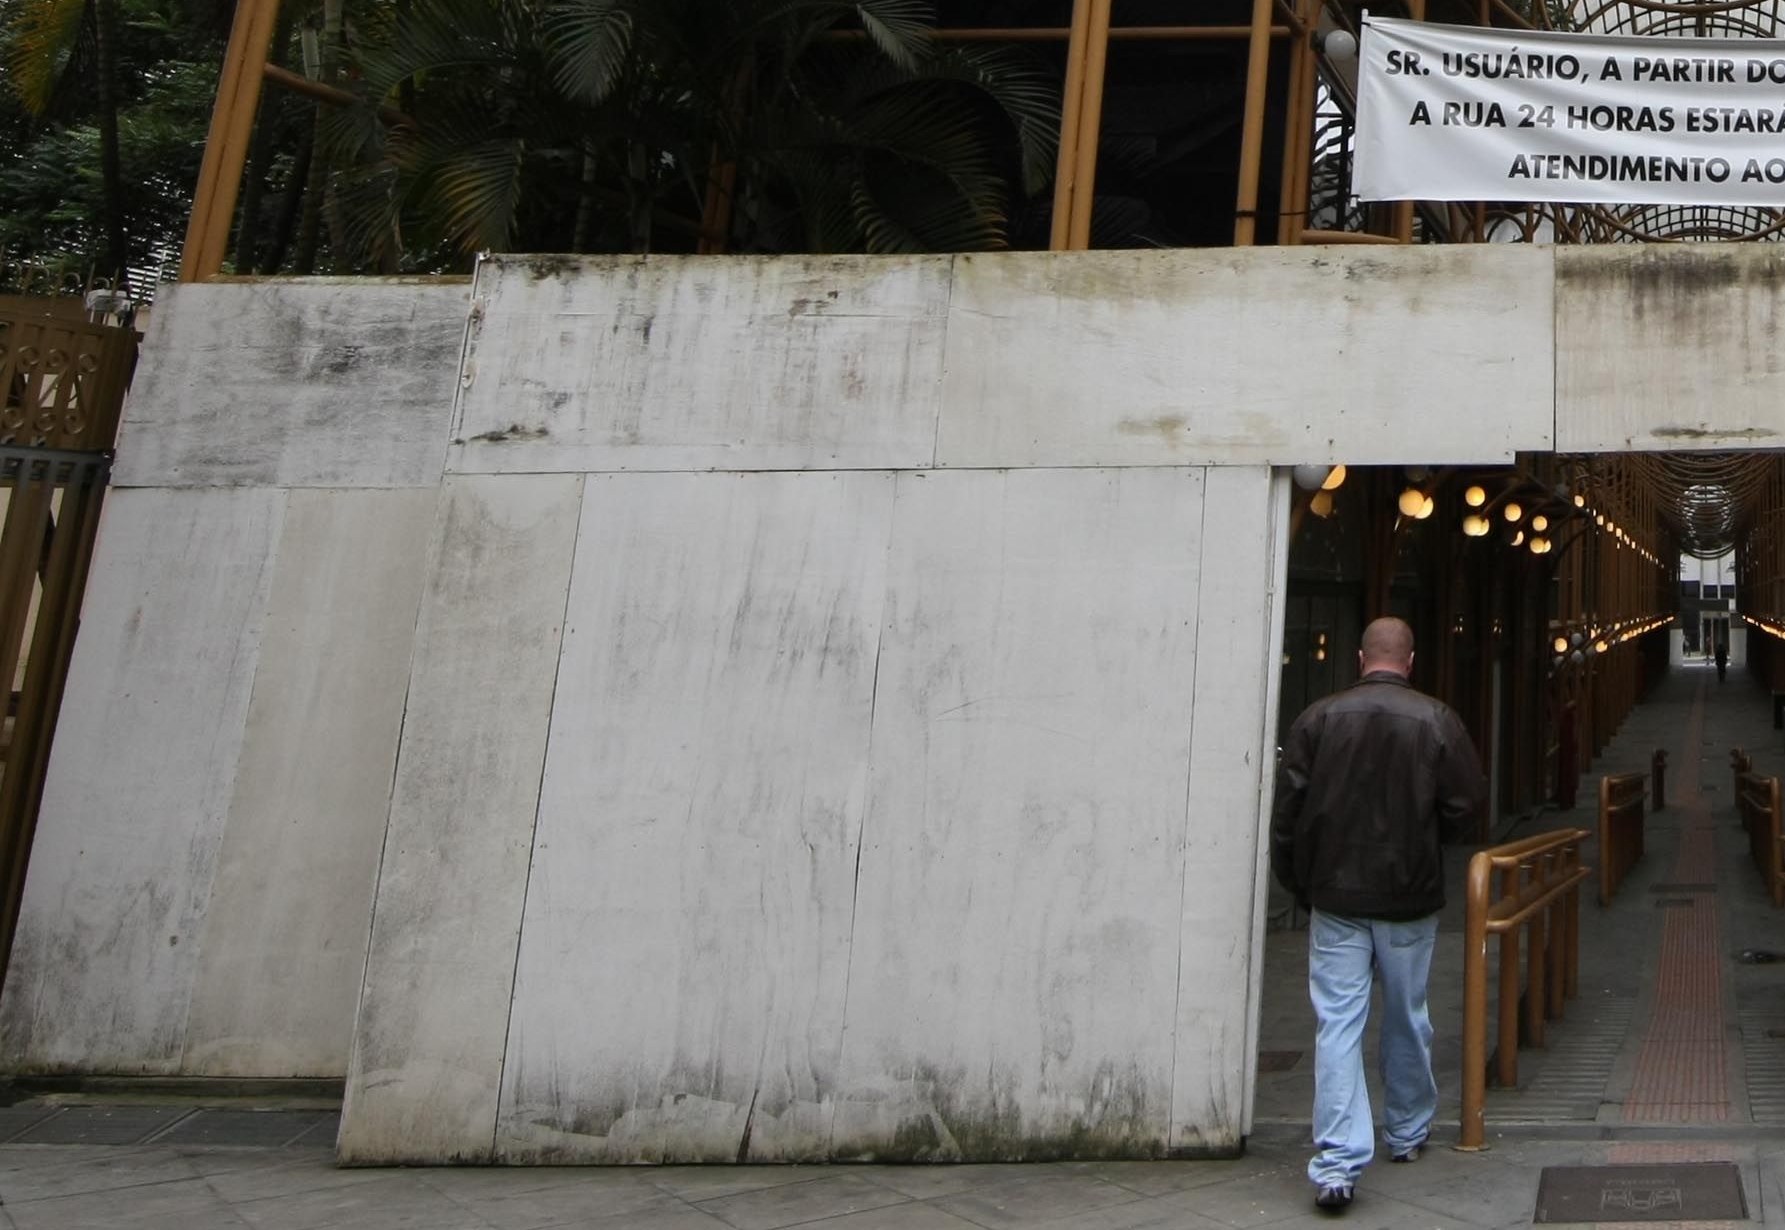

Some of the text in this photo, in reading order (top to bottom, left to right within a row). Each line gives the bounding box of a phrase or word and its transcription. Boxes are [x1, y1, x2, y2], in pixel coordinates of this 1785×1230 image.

[1385, 50, 1431, 76] SR.
[1442, 46, 1591, 84] USUÁRIO,
[1600, 57, 1622, 82] A
[1633, 57, 1737, 83] PARTIR
[1409, 101, 1432, 126] A
[1443, 102, 1506, 128] RUA
[1517, 104, 1556, 128] 24
[1567, 105, 1675, 132] HORAS
[1508, 154, 1731, 183] ATENDIMENTO
